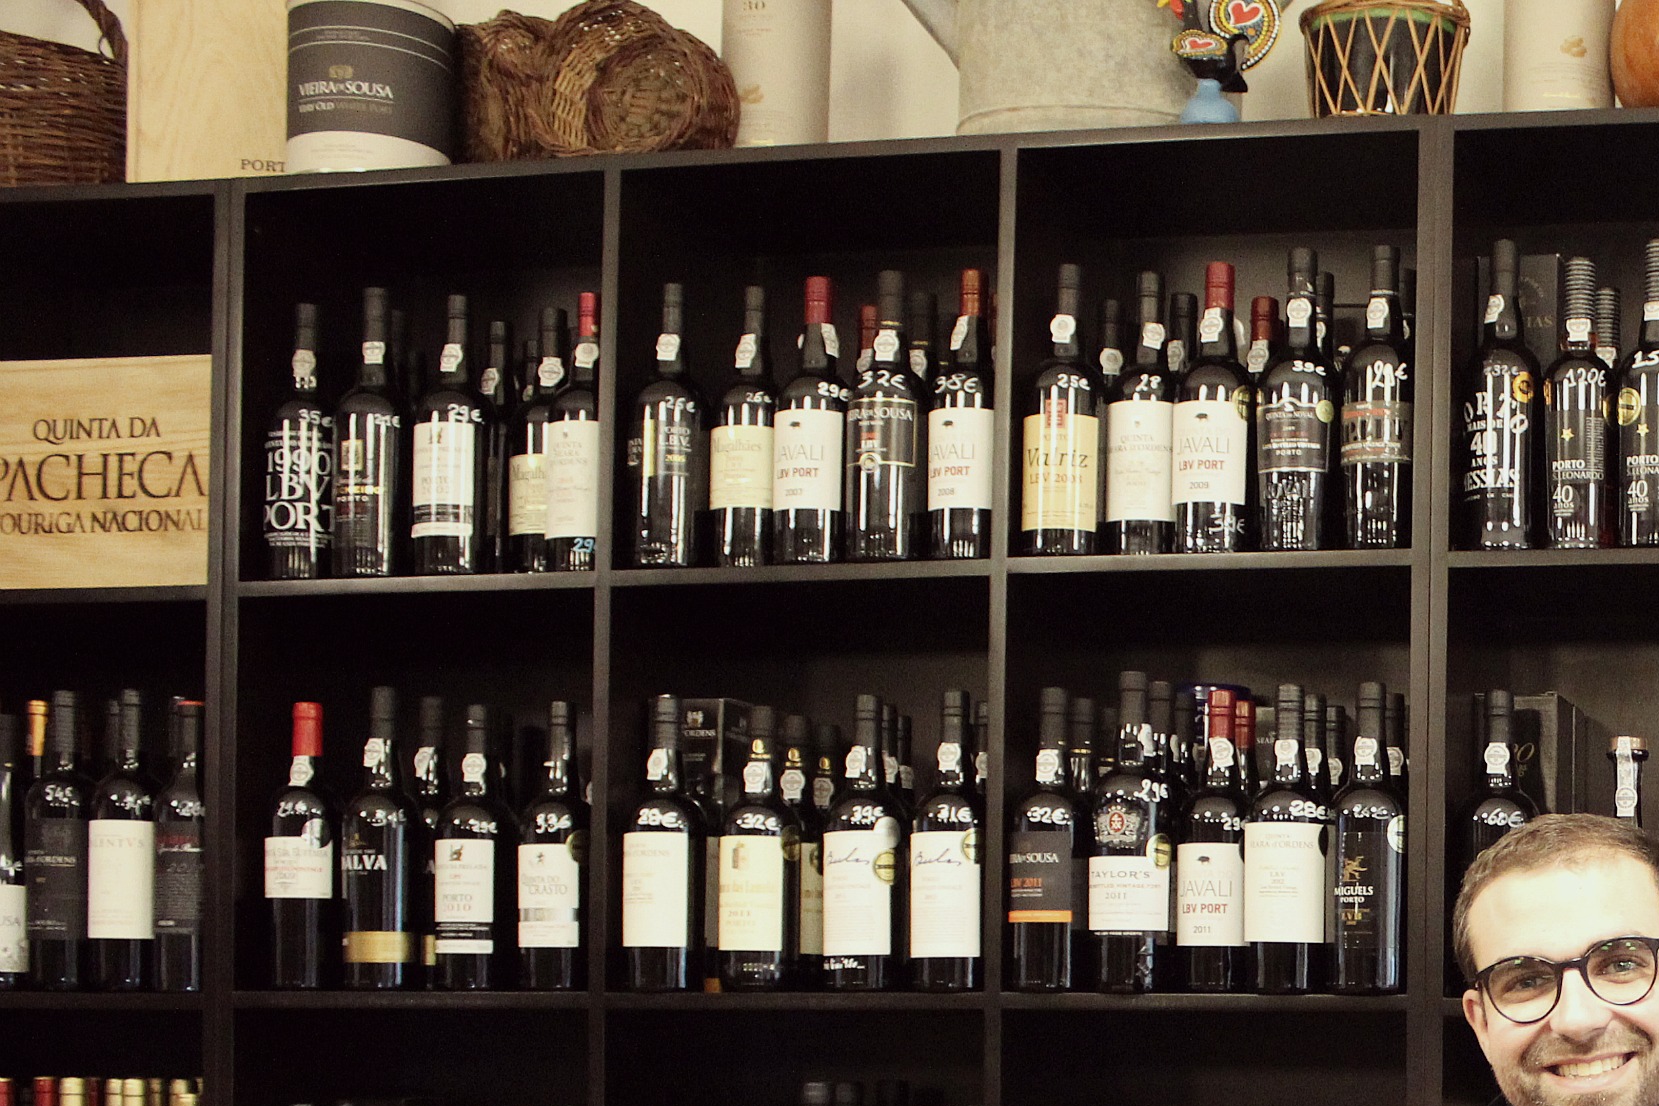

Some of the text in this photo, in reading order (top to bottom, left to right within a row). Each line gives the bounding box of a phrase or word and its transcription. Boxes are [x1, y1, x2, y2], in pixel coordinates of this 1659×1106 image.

[299, 81, 336, 96] VIEIRA
[345, 81, 393, 99] SOUSA
[241, 159, 286, 173] PORT
[33, 417, 161, 445] QUINTA DA
[1177, 438, 1230, 455] JAVALI
[266, 448, 331, 476] 1990
[1178, 458, 1225, 472] LBV PORT
[1552, 459, 1585, 471] PORTO
[1627, 455, 1659, 467] PORTO
[1553, 484, 1573, 504] 40
[1627, 480, 1649, 498] 40
[0, 508, 205, 535] OURIGA NACIONAL
[1091, 870, 1151, 880] TAYLOR'S
[1180, 880, 1233, 898] JAVALI
[1335, 885, 1374, 897] MIGUELS
[1182, 902, 1228, 914] LBV PORT
